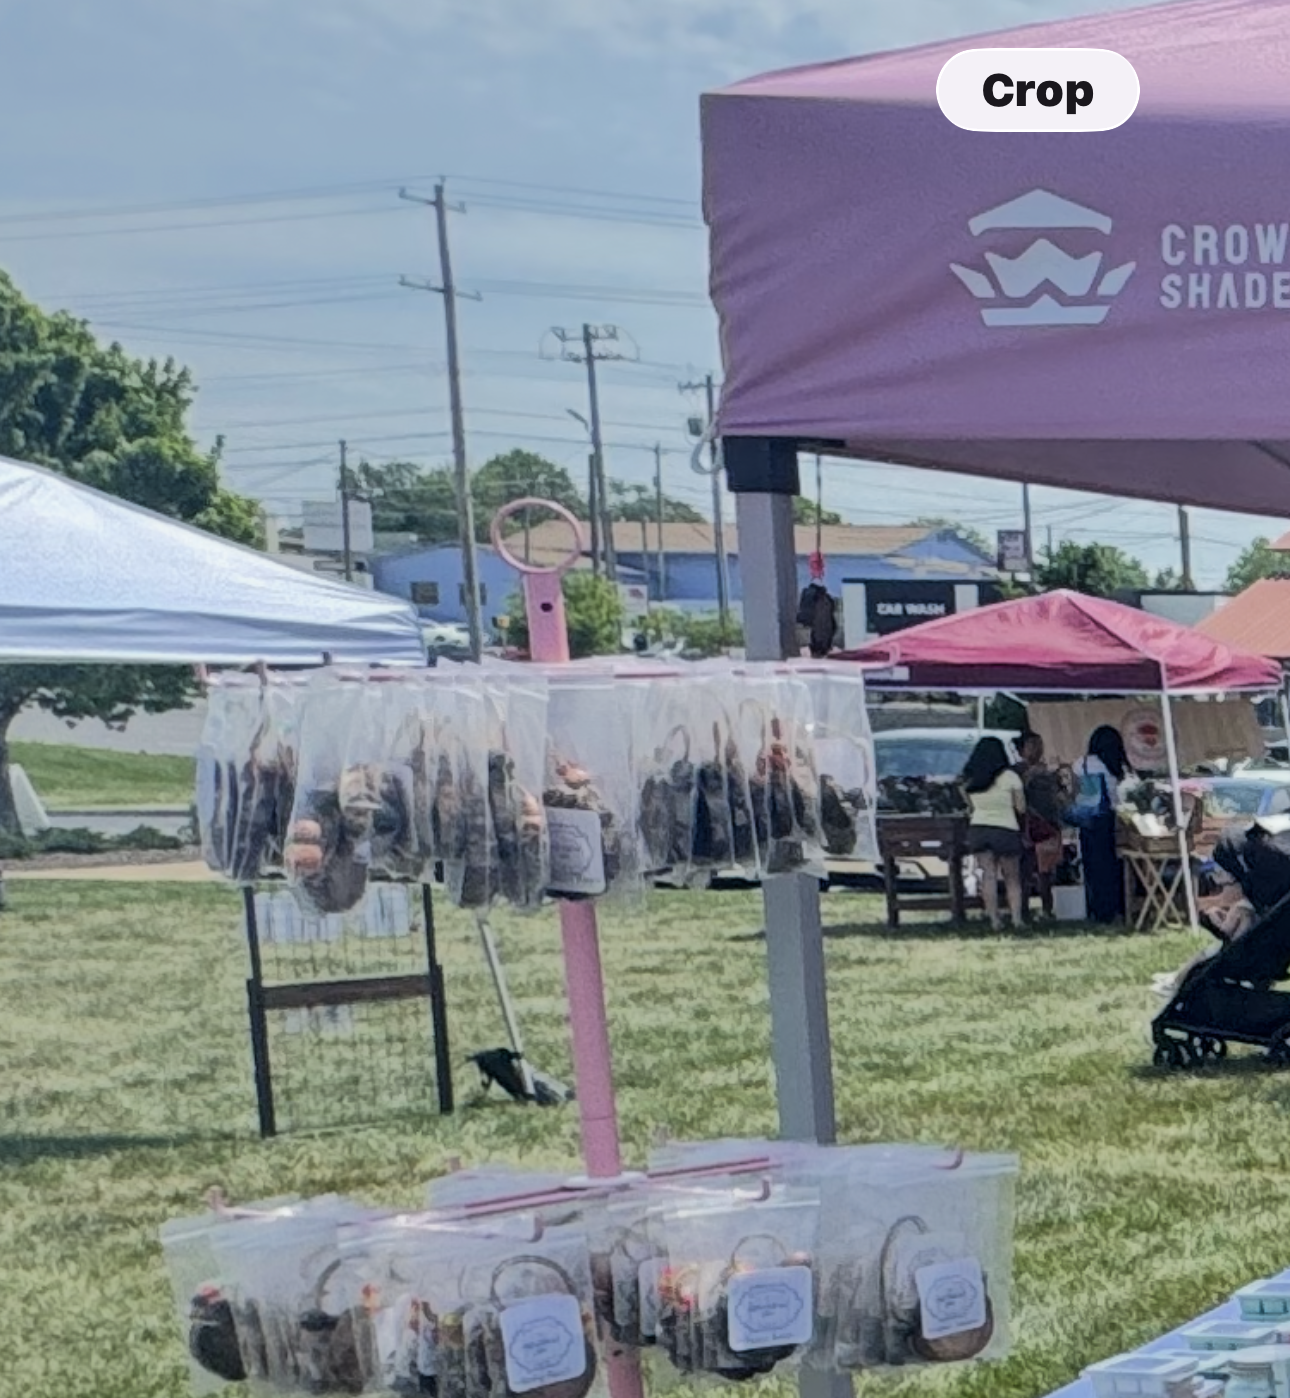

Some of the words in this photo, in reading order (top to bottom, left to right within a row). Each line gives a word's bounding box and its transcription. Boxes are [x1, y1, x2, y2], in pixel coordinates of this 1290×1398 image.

[1161, 223, 1289, 266] CROW
[1160, 271, 1290, 309] SHADE
[876, 602, 903, 615] CAR
[904, 603, 946, 615] WASH
